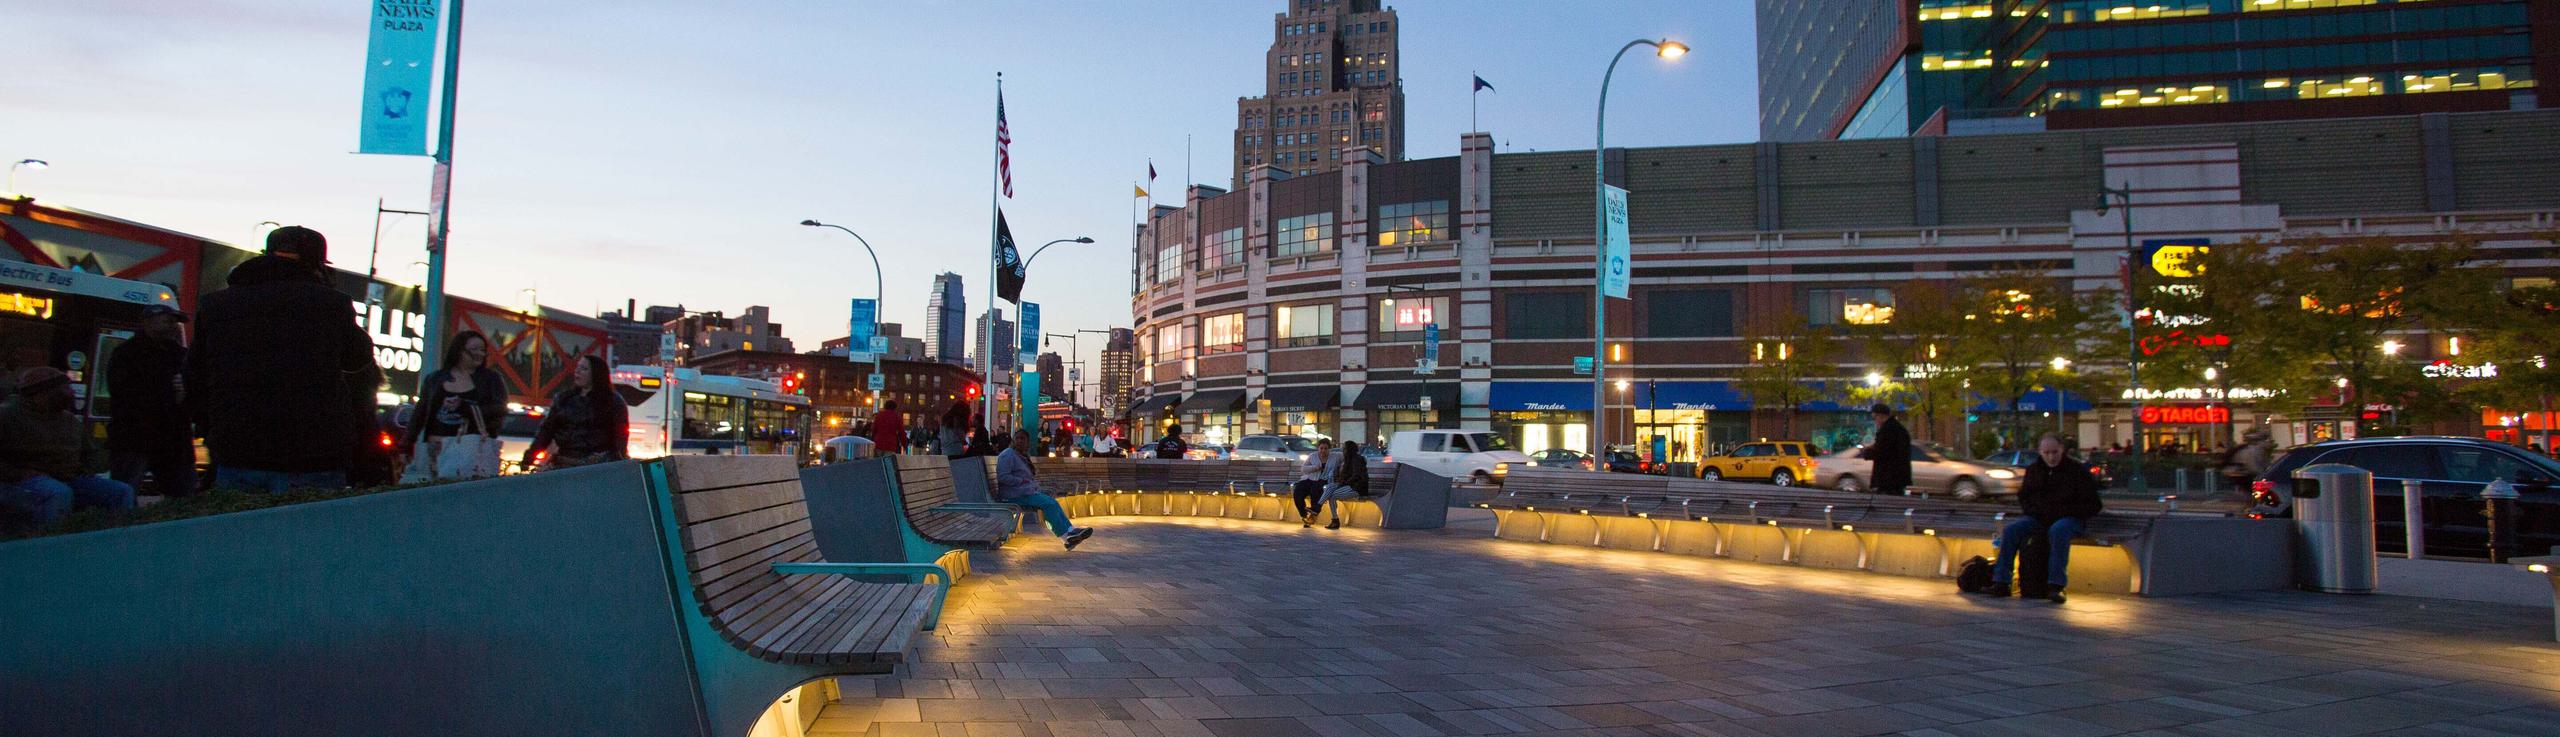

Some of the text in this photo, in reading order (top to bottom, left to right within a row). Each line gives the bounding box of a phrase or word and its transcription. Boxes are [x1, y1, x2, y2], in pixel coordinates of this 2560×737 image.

[379, 4, 435, 18] NEWS
[385, 20, 424, 32] PLAZA
[48, 271, 73, 286] Bus
[1524, 402, 1566, 410] Mandee
[2160, 408, 2229, 423] TARGET
